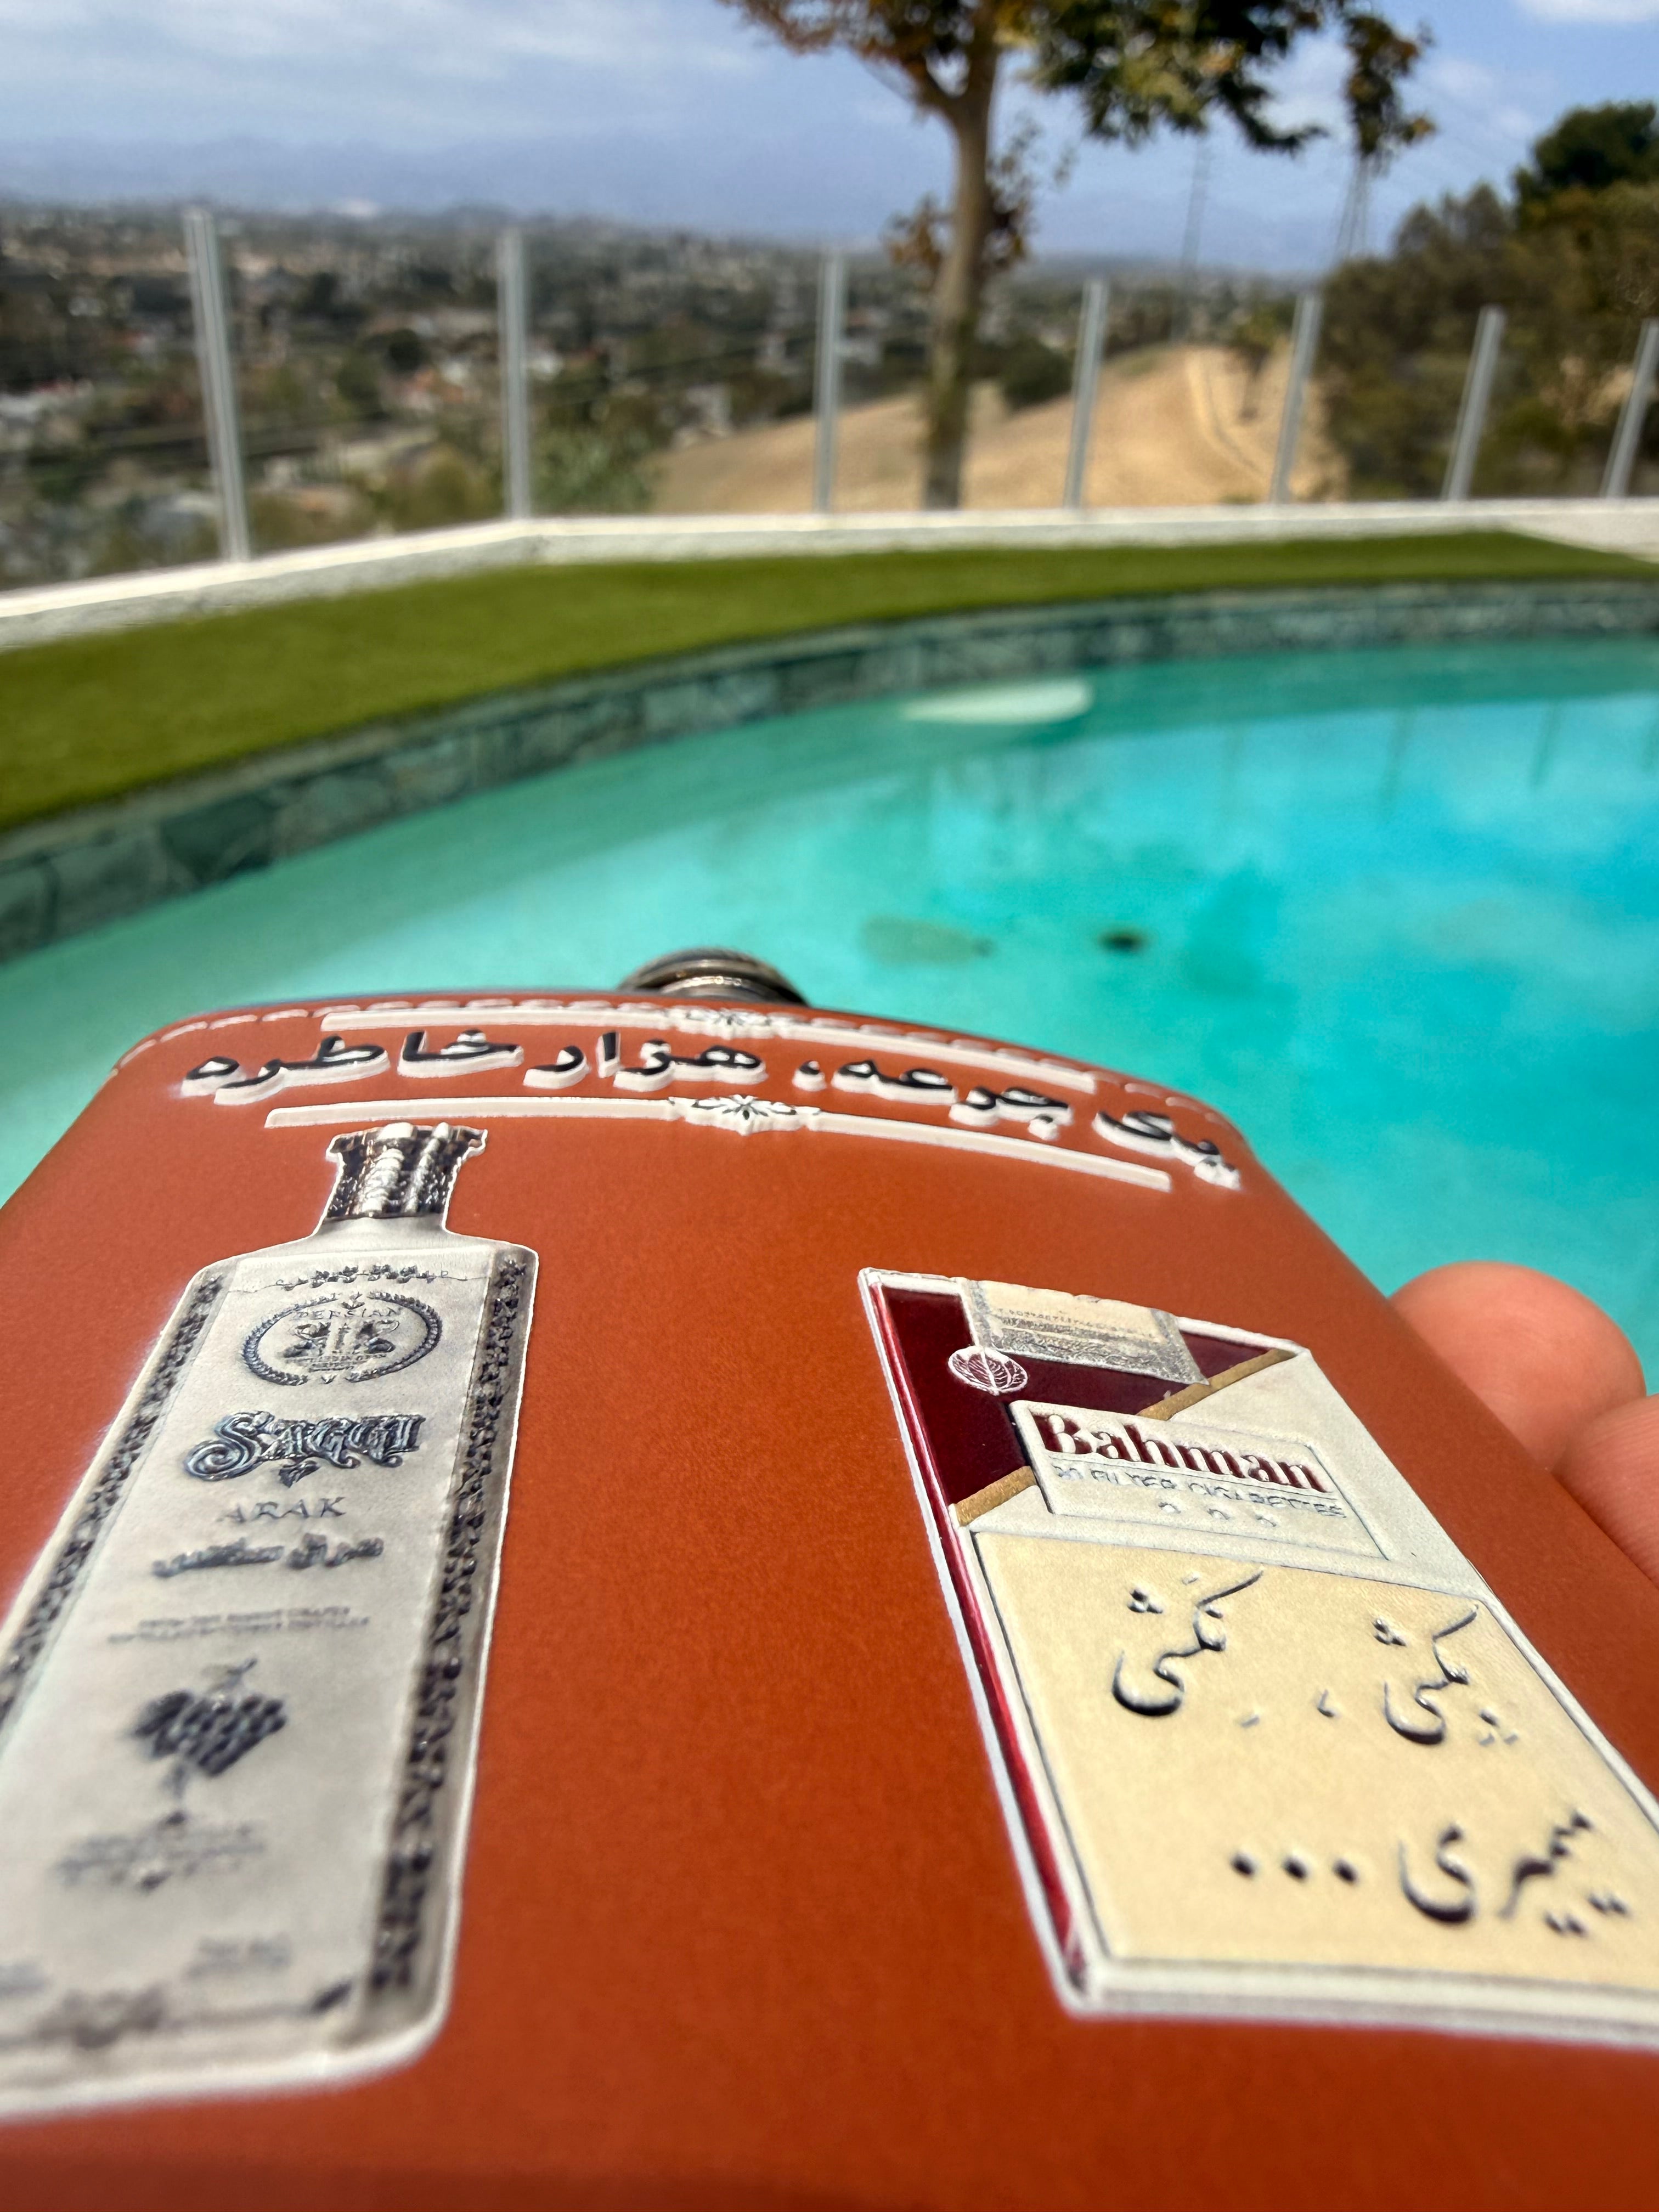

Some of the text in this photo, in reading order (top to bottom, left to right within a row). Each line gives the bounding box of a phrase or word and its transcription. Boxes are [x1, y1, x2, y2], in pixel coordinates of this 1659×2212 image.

[181, 1029, 523, 1105] خاطره
[524, 1030, 767, 1093] هزار
[1029, 1413, 1328, 1493] Bahman
